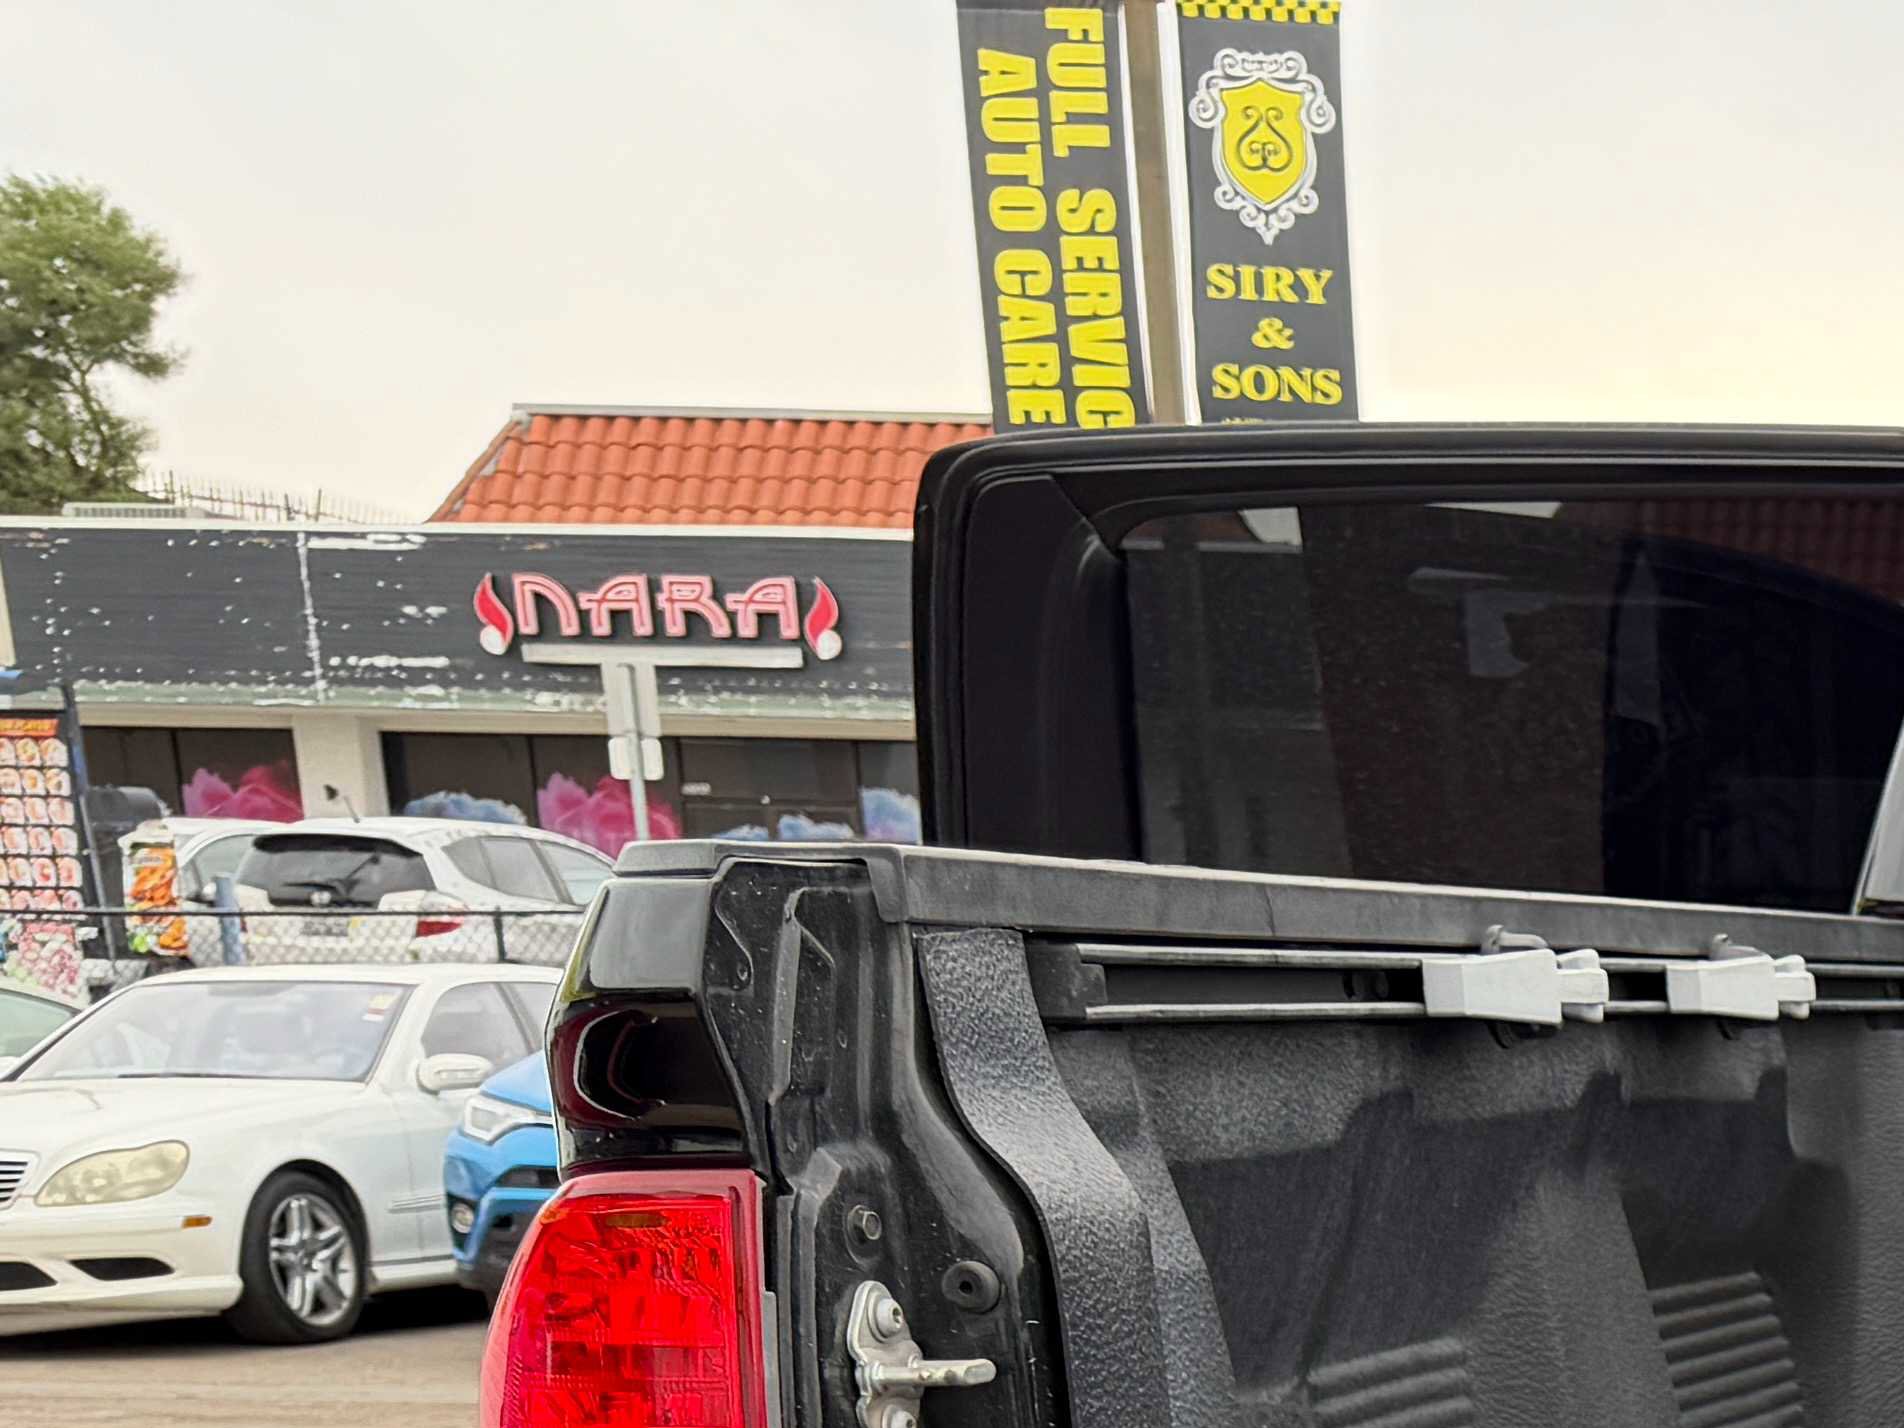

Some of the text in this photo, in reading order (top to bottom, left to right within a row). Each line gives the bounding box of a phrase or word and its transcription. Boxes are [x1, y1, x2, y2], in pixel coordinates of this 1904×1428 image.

[977, 48, 1067, 425] AUTO CARE
[1045, 7, 1136, 429] FULL SERVIC
[1205, 263, 1333, 305] SIRY
[1250, 317, 1295, 350] &
[1211, 362, 1343, 405] SONS
[512, 571, 803, 641] NARA
